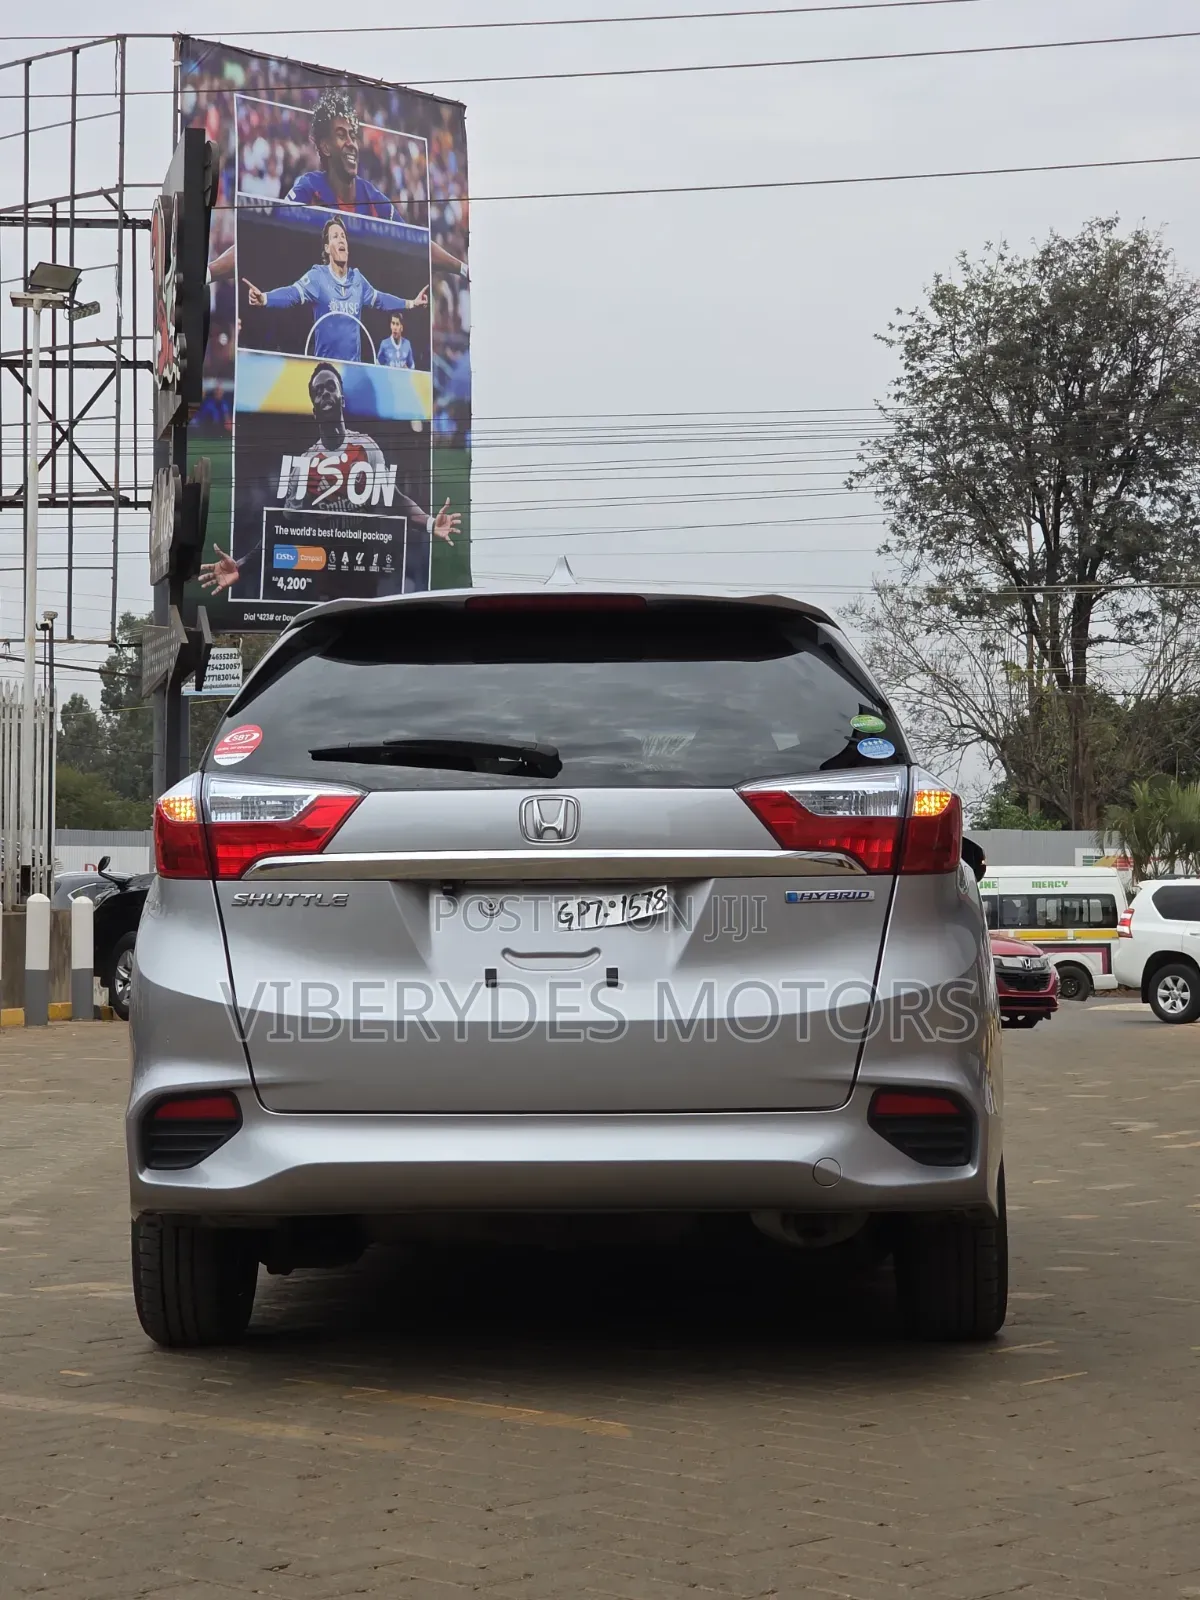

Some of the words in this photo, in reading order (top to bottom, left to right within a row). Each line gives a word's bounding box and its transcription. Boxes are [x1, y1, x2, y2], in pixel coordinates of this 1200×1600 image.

[277, 453, 348, 506] IT'S
[347, 461, 398, 507] ON
[275, 525, 289, 535] The
[290, 526, 316, 537] world's
[317, 528, 333, 537] best
[334, 529, 362, 539] football
[362, 531, 393, 543] package
[277, 576, 307, 591] 4,200
[243, 613, 256, 621] Dial
[1032, 880, 1069, 889] MERCY
[231, 892, 349, 908] SHUTTLE
[800, 891, 870, 901] HYBRID
